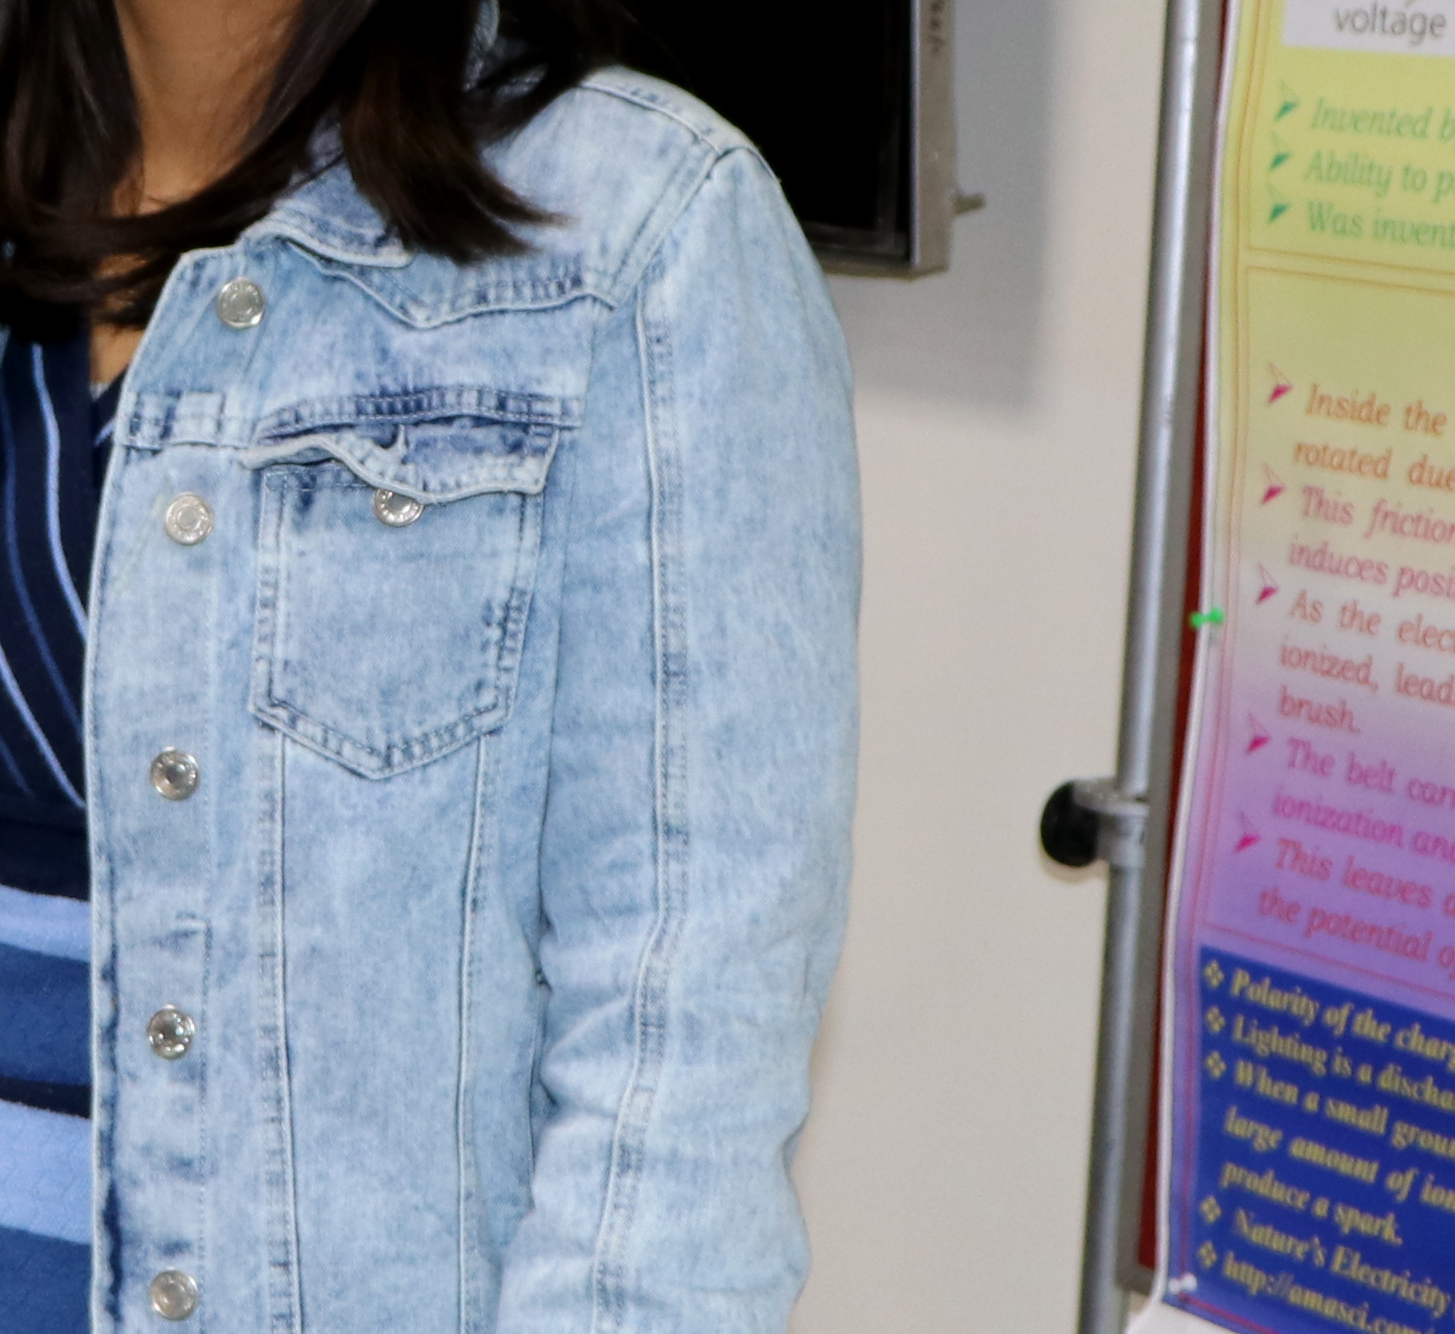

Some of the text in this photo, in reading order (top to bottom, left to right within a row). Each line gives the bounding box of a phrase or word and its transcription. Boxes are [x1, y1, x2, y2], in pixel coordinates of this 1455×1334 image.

[1334, 3, 1447, 45] voltage
[1310, 97, 1432, 140] Invented
[1304, 150, 1393, 195] Ability
[1402, 159, 1427, 192] to
[1306, 200, 1363, 238] Was
[1306, 383, 1390, 426] Inside
[1404, 399, 1448, 436] the
[1300, 484, 1354, 527] This
[1289, 541, 1388, 584] induces
[1331, 1245, 1450, 1318] Electricity
